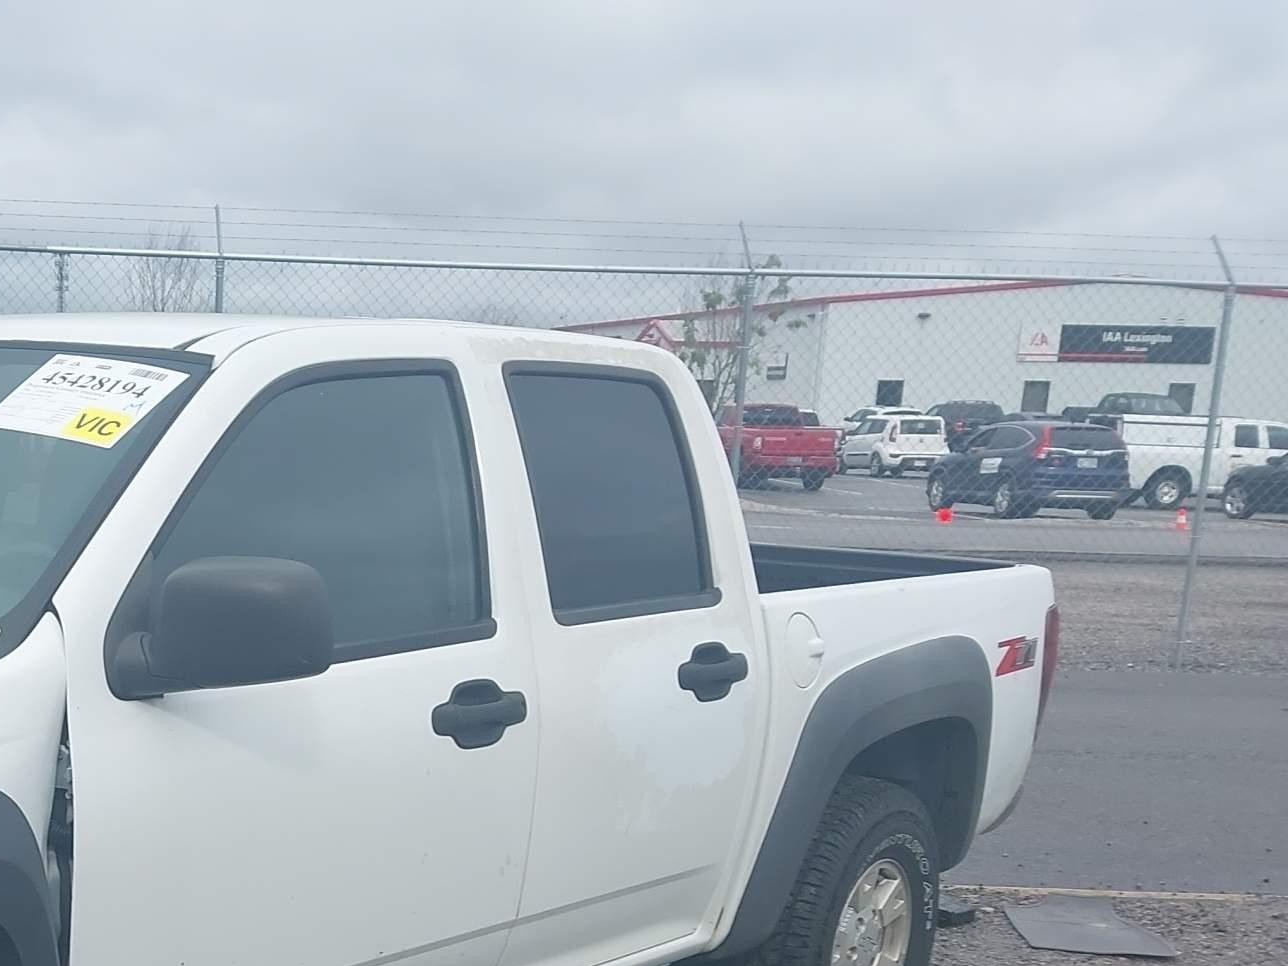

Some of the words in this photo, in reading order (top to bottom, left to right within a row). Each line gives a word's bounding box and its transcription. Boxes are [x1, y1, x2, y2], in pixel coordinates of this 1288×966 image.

[1102, 331, 1122, 342] IAA
[1124, 332, 1173, 345] Lexington
[40, 369, 152, 399] 45428194
[75, 413, 122, 437] VIC
